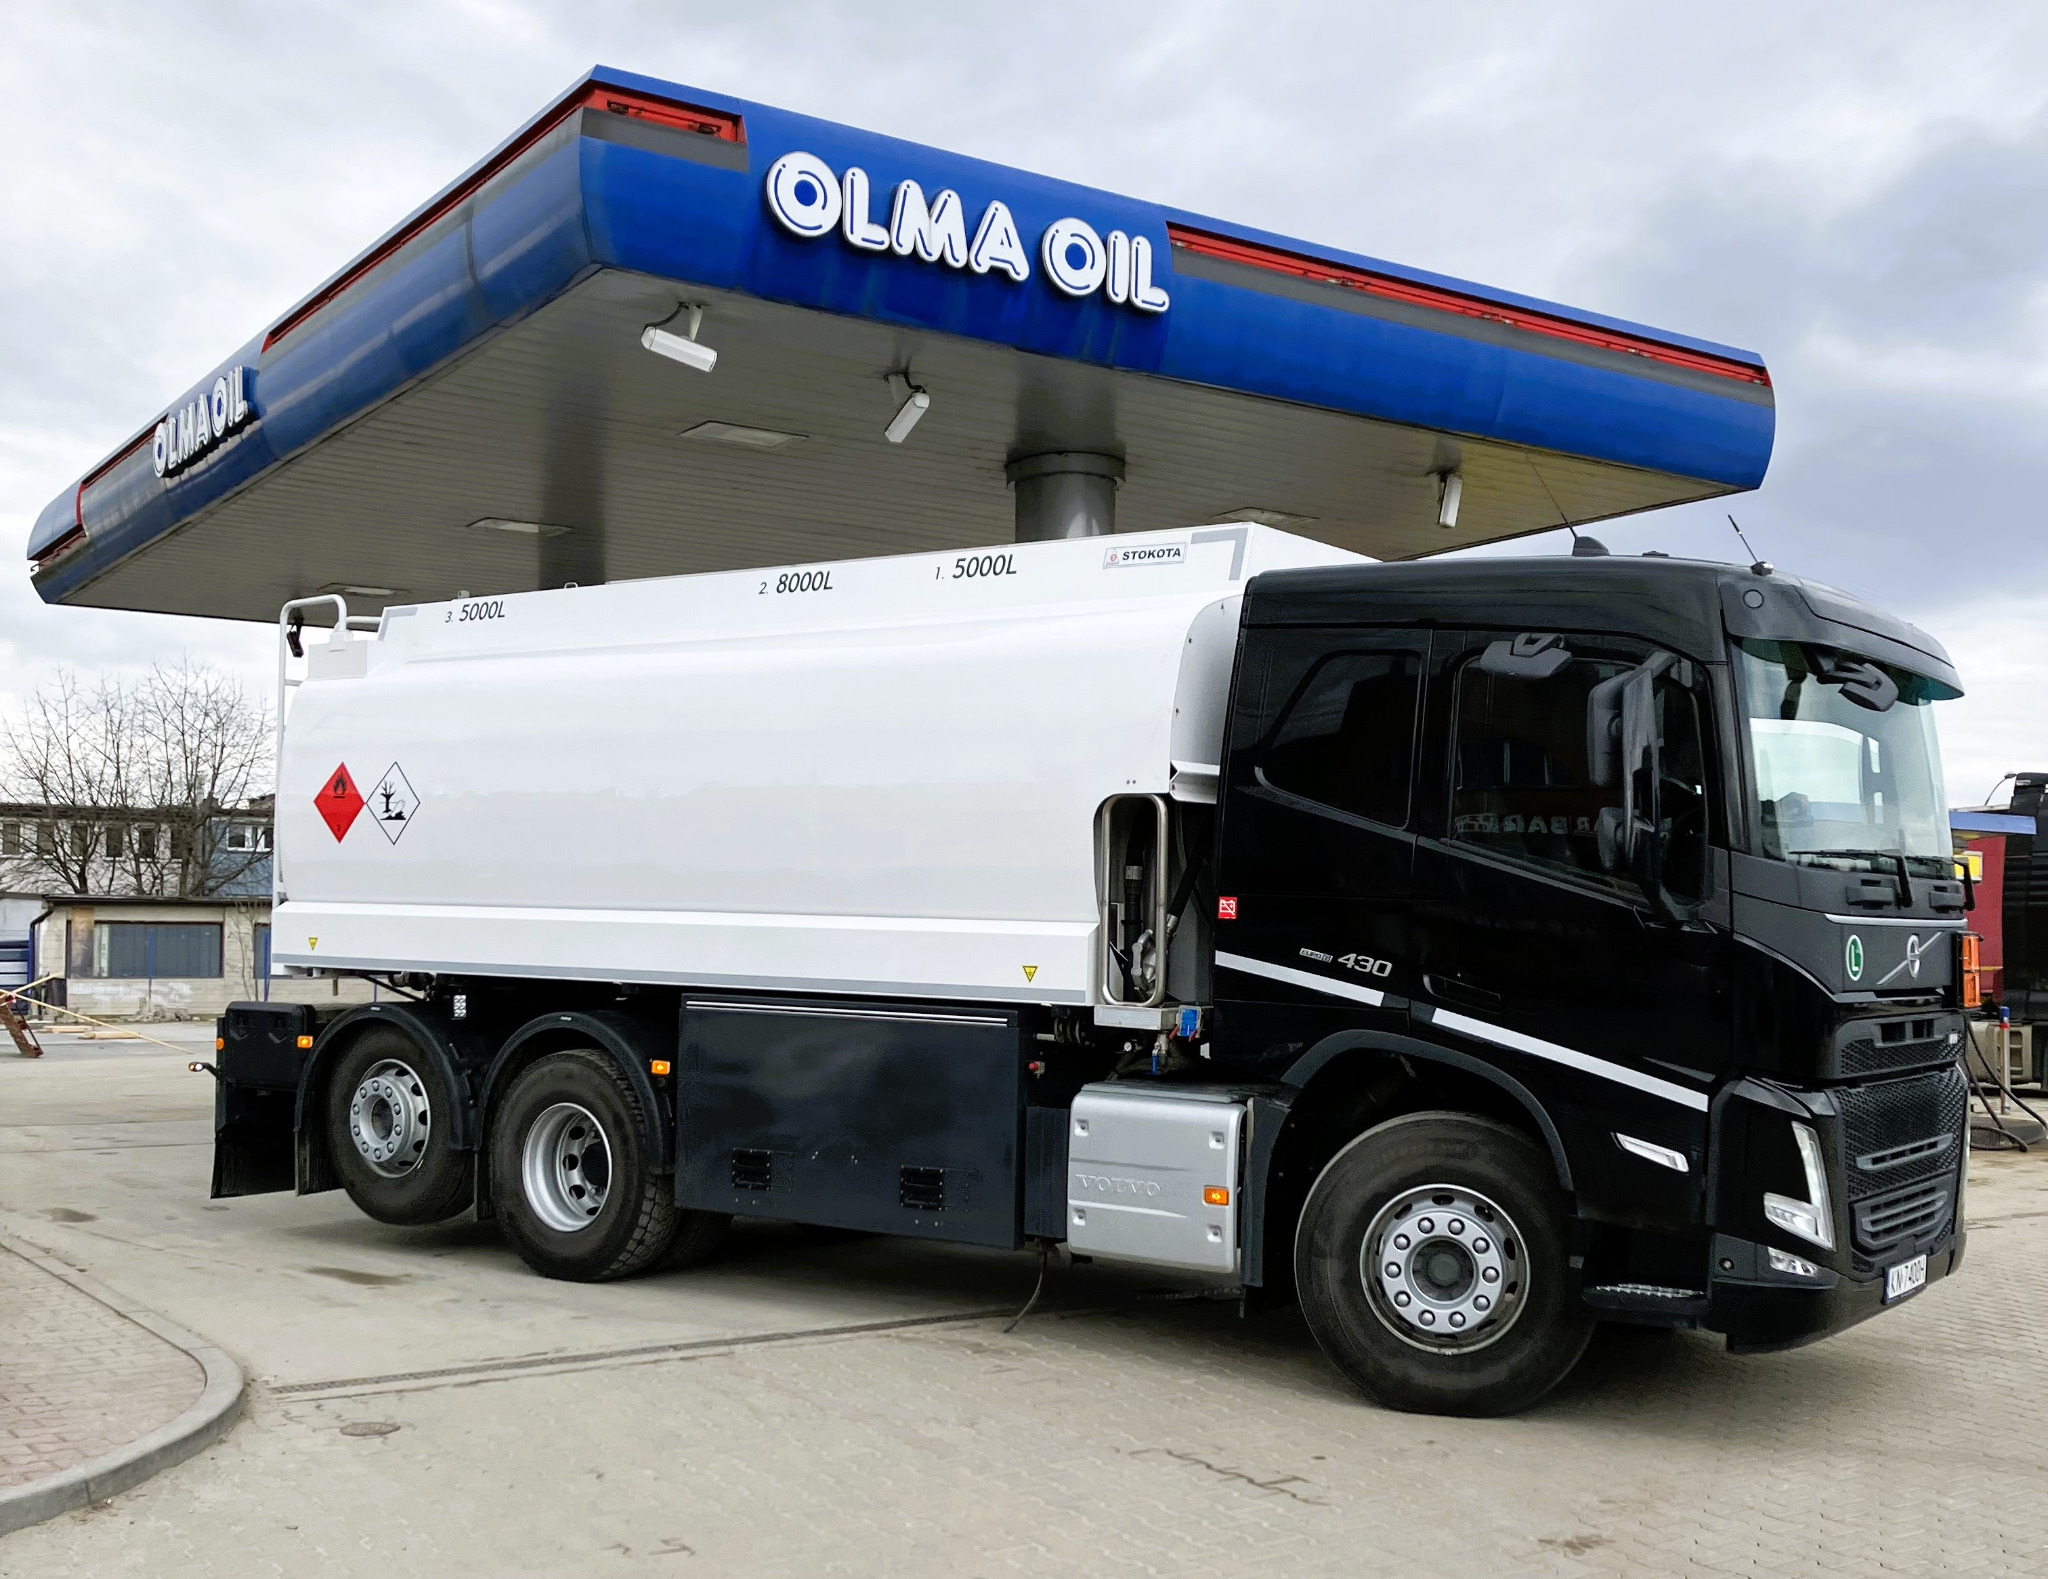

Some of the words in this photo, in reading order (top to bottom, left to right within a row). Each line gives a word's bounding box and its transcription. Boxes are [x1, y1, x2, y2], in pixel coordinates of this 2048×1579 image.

[767, 150, 1031, 282] OLMA
[1042, 216, 1171, 314] OIL
[153, 393, 212, 478] OLMA
[211, 364, 249, 438] OIL
[952, 554, 1017, 579] 5000L
[1122, 547, 1181, 561] STOKOTA
[776, 570, 833, 593] 8000L
[459, 601, 505, 621] 5000L
[1338, 953, 1393, 978] 430
